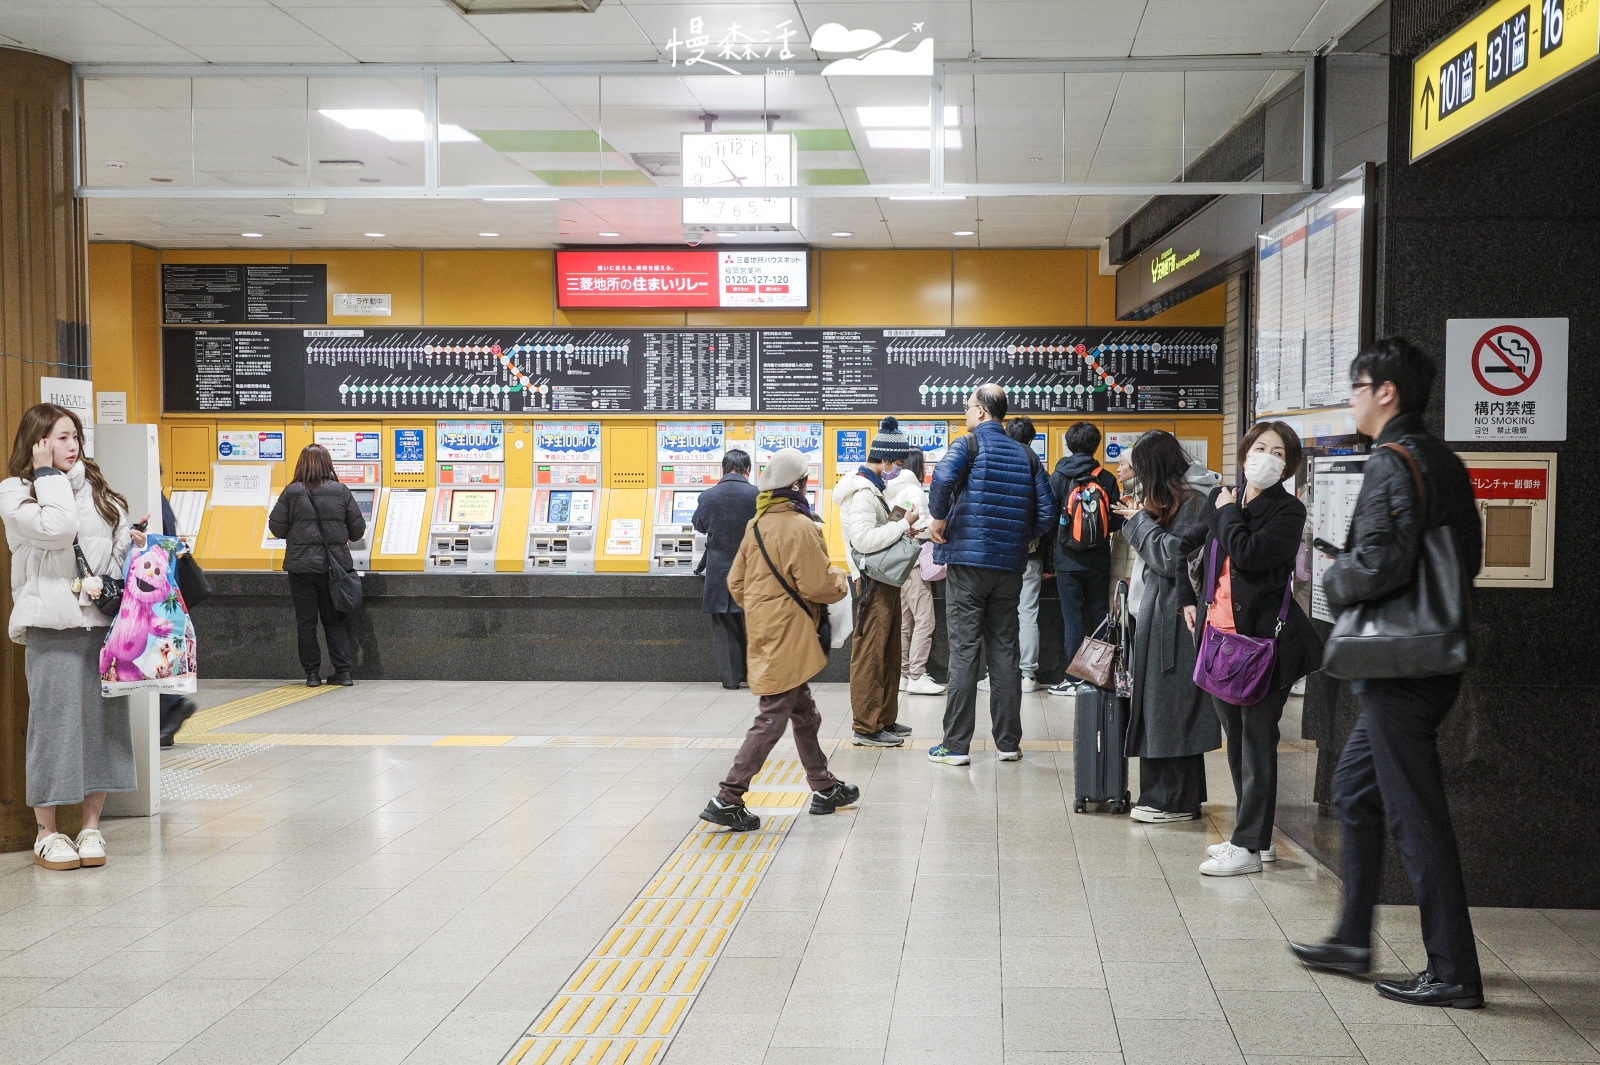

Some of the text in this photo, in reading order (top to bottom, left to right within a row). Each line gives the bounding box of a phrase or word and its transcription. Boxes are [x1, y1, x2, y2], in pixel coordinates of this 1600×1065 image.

[1542, 0, 1563, 50] 16
[1440, 63, 1457, 114] 10
[716, 145, 725, 158] 11
[730, 141, 743, 155] 12
[700, 155, 711, 169] 10
[693, 173, 702, 186] 9
[772, 173, 780, 186] 3
[732, 204, 742, 218] 6
[748, 201, 757, 214] 5
[736, 256, 802, 264] 三菱地所ハウスネット
[566, 277, 709, 291] 三菱地所の住まいリレー
[725, 275, 789, 284] 0120-127-120
[49, 394, 87, 407] HAKATA
[1474, 400, 1536, 416] 構内禁煙
[506, 421, 515, 434] 2
[521, 421, 531, 434] 3
[726, 421, 736, 434] 4
[949, 421, 959, 434] 6
[1474, 417, 1535, 425] NO SMOKING
[743, 421, 753, 435] 5
[1474, 426, 1489, 435] 금연
[1496, 426, 1528, 435] 禁止吸烟
